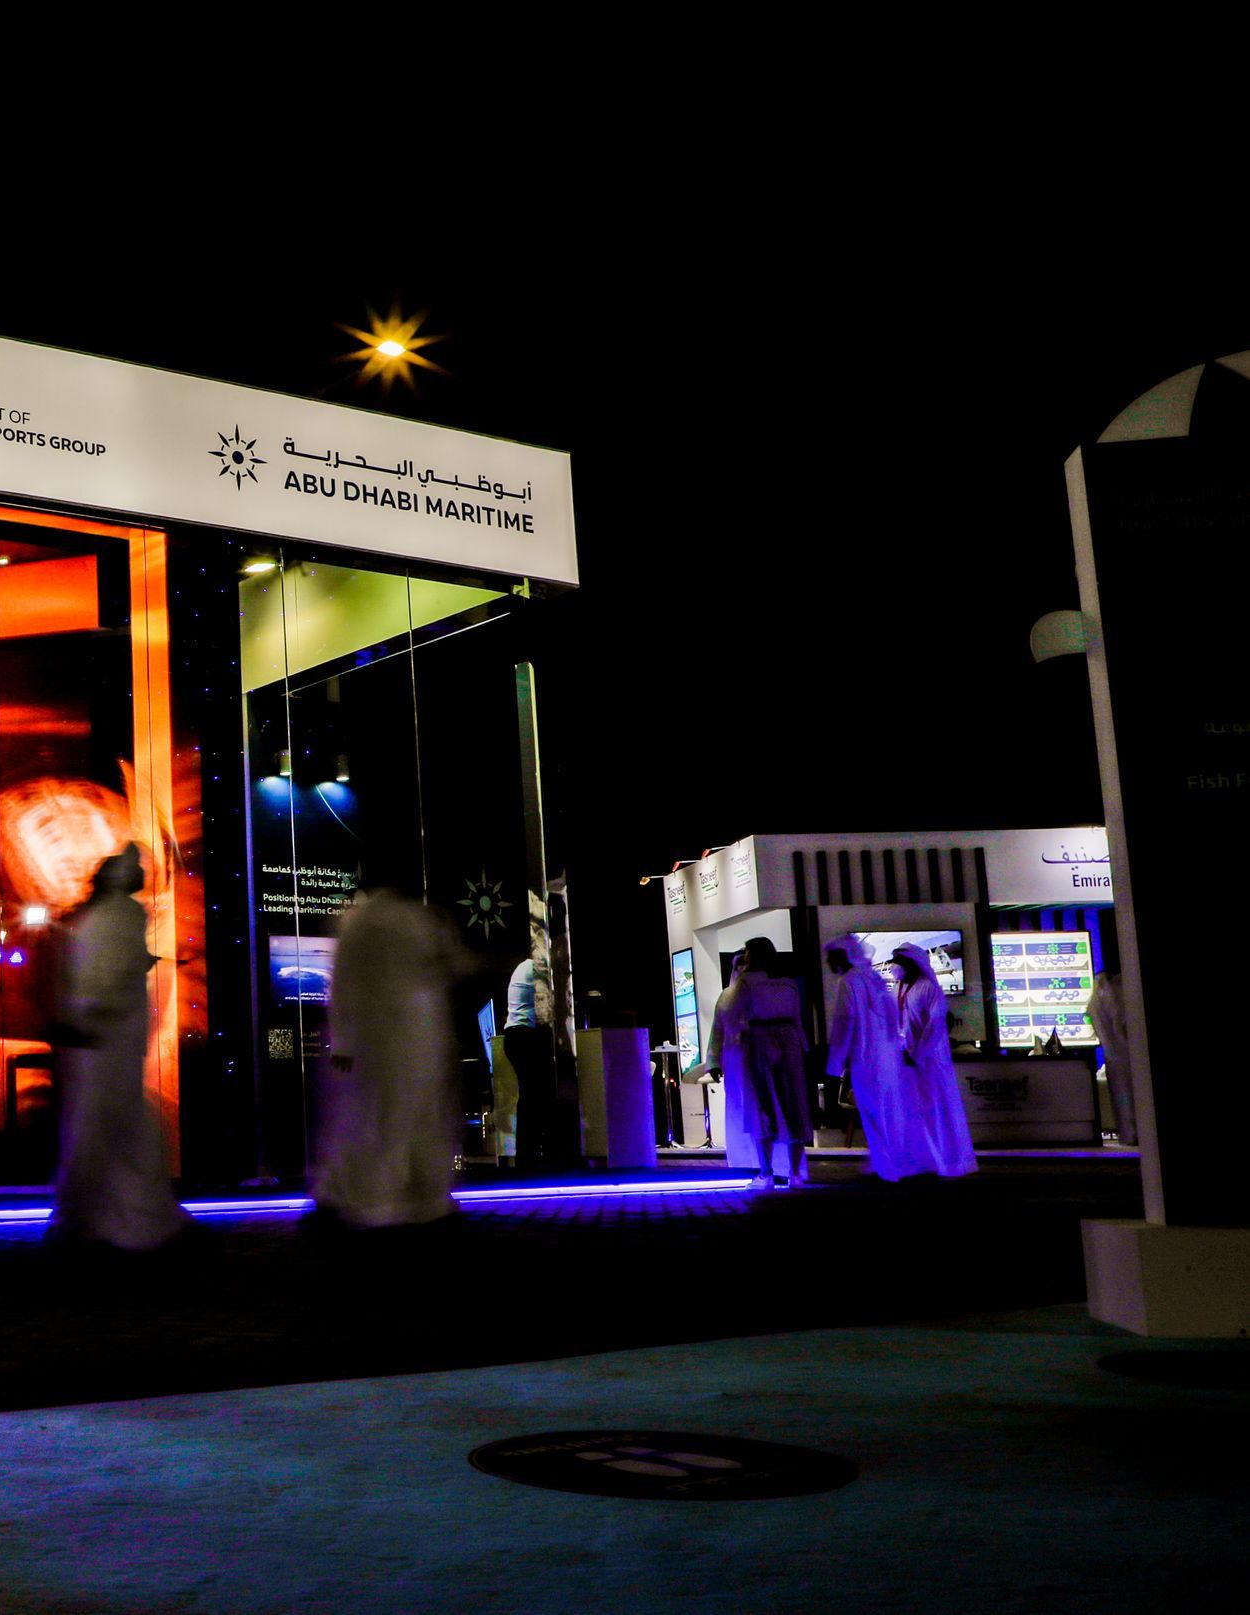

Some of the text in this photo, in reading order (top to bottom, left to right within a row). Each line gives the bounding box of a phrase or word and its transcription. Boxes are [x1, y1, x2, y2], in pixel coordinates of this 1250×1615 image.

[9, 410, 31, 425] OF
[49, 436, 106, 456] GROUP
[283, 437, 532, 504] أبوظبي البحرية
[284, 470, 535, 534] ABU DHABI MARITIME
[1072, 874, 1111, 888] Emira
[306, 895, 321, 903] Abu
[263, 904, 293, 915] Leading
[294, 906, 326, 915] aritime
